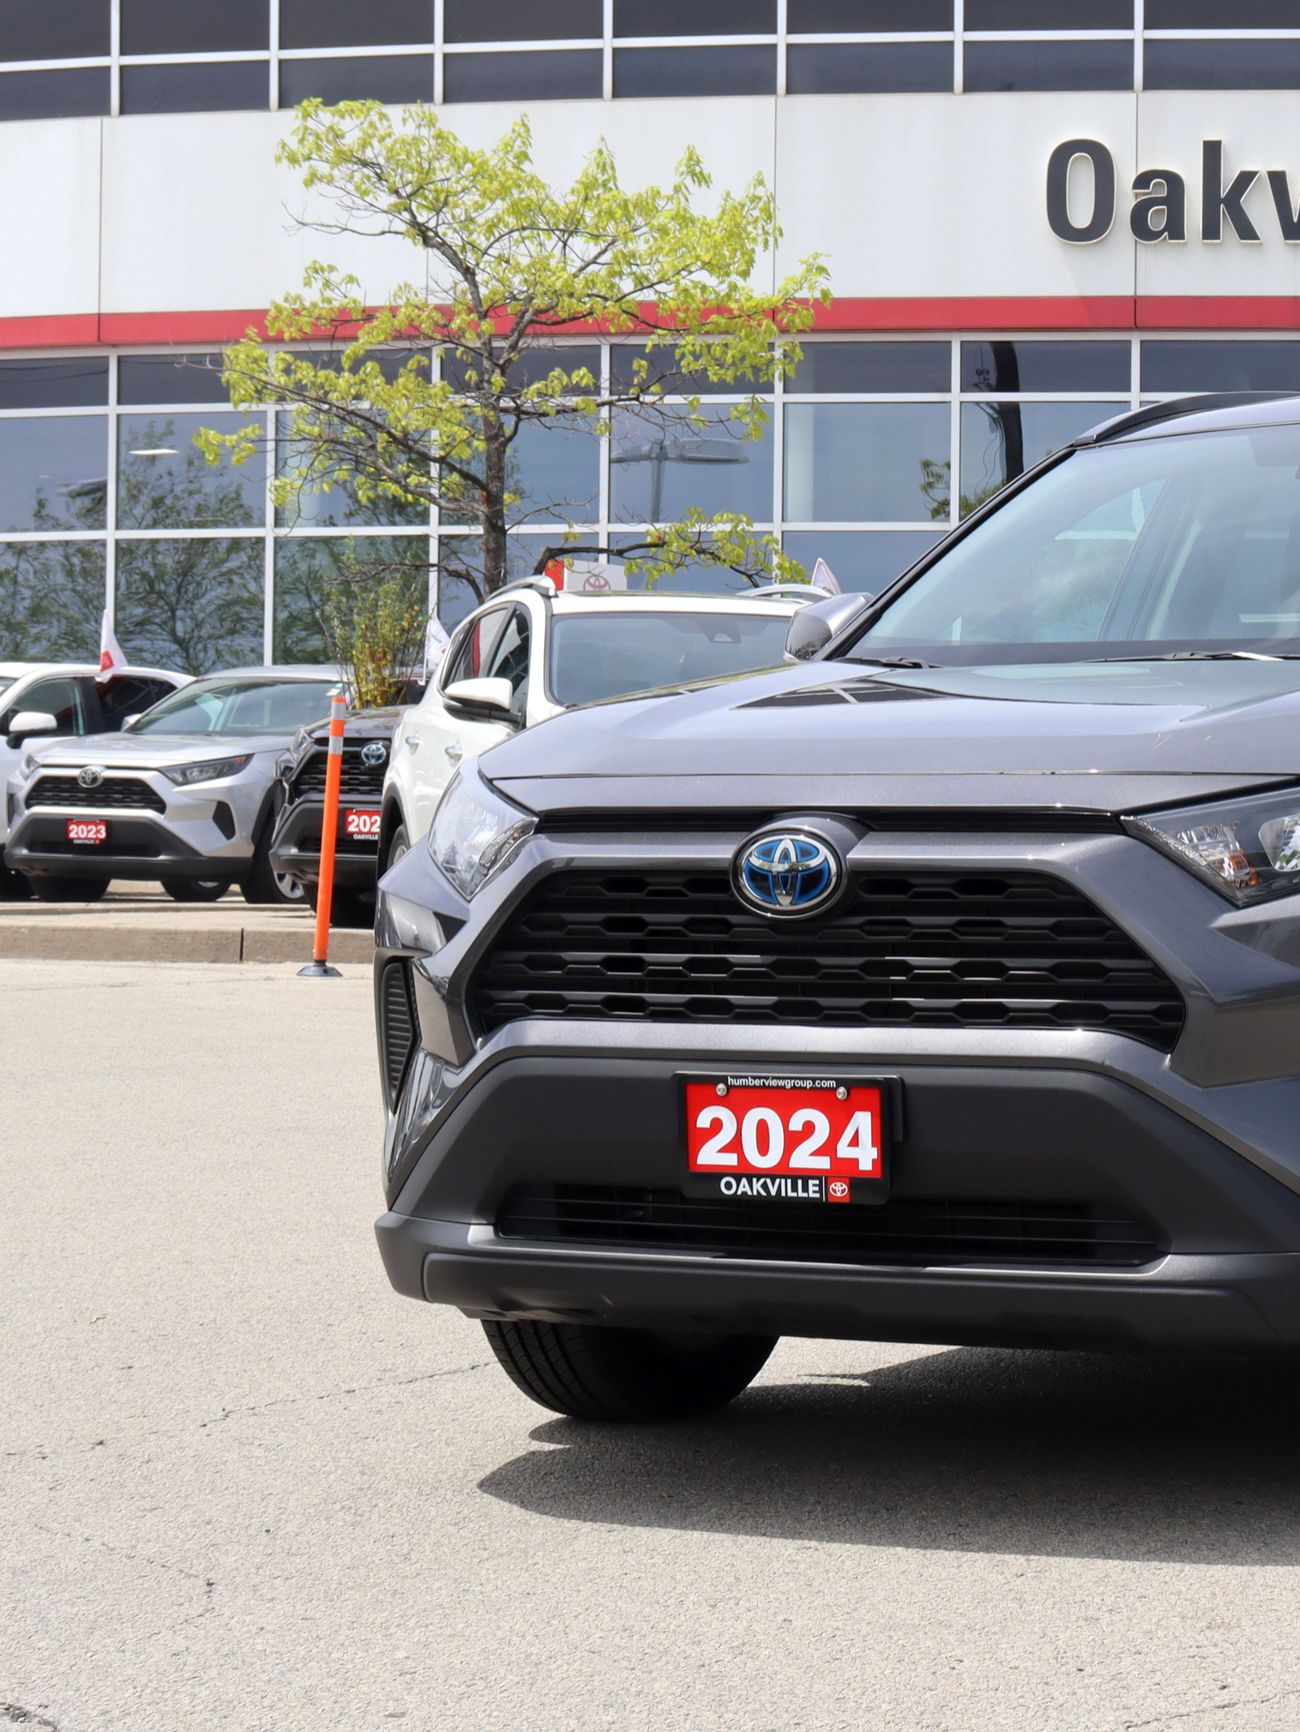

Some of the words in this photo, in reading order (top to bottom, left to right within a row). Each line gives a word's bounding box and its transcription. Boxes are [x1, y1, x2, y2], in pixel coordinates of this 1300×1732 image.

[68, 824, 106, 839] 2023
[727, 1075, 837, 1090] humberviewgroup.com
[696, 1105, 878, 1171] 2024
[720, 1175, 820, 1198] OAKVILLE
